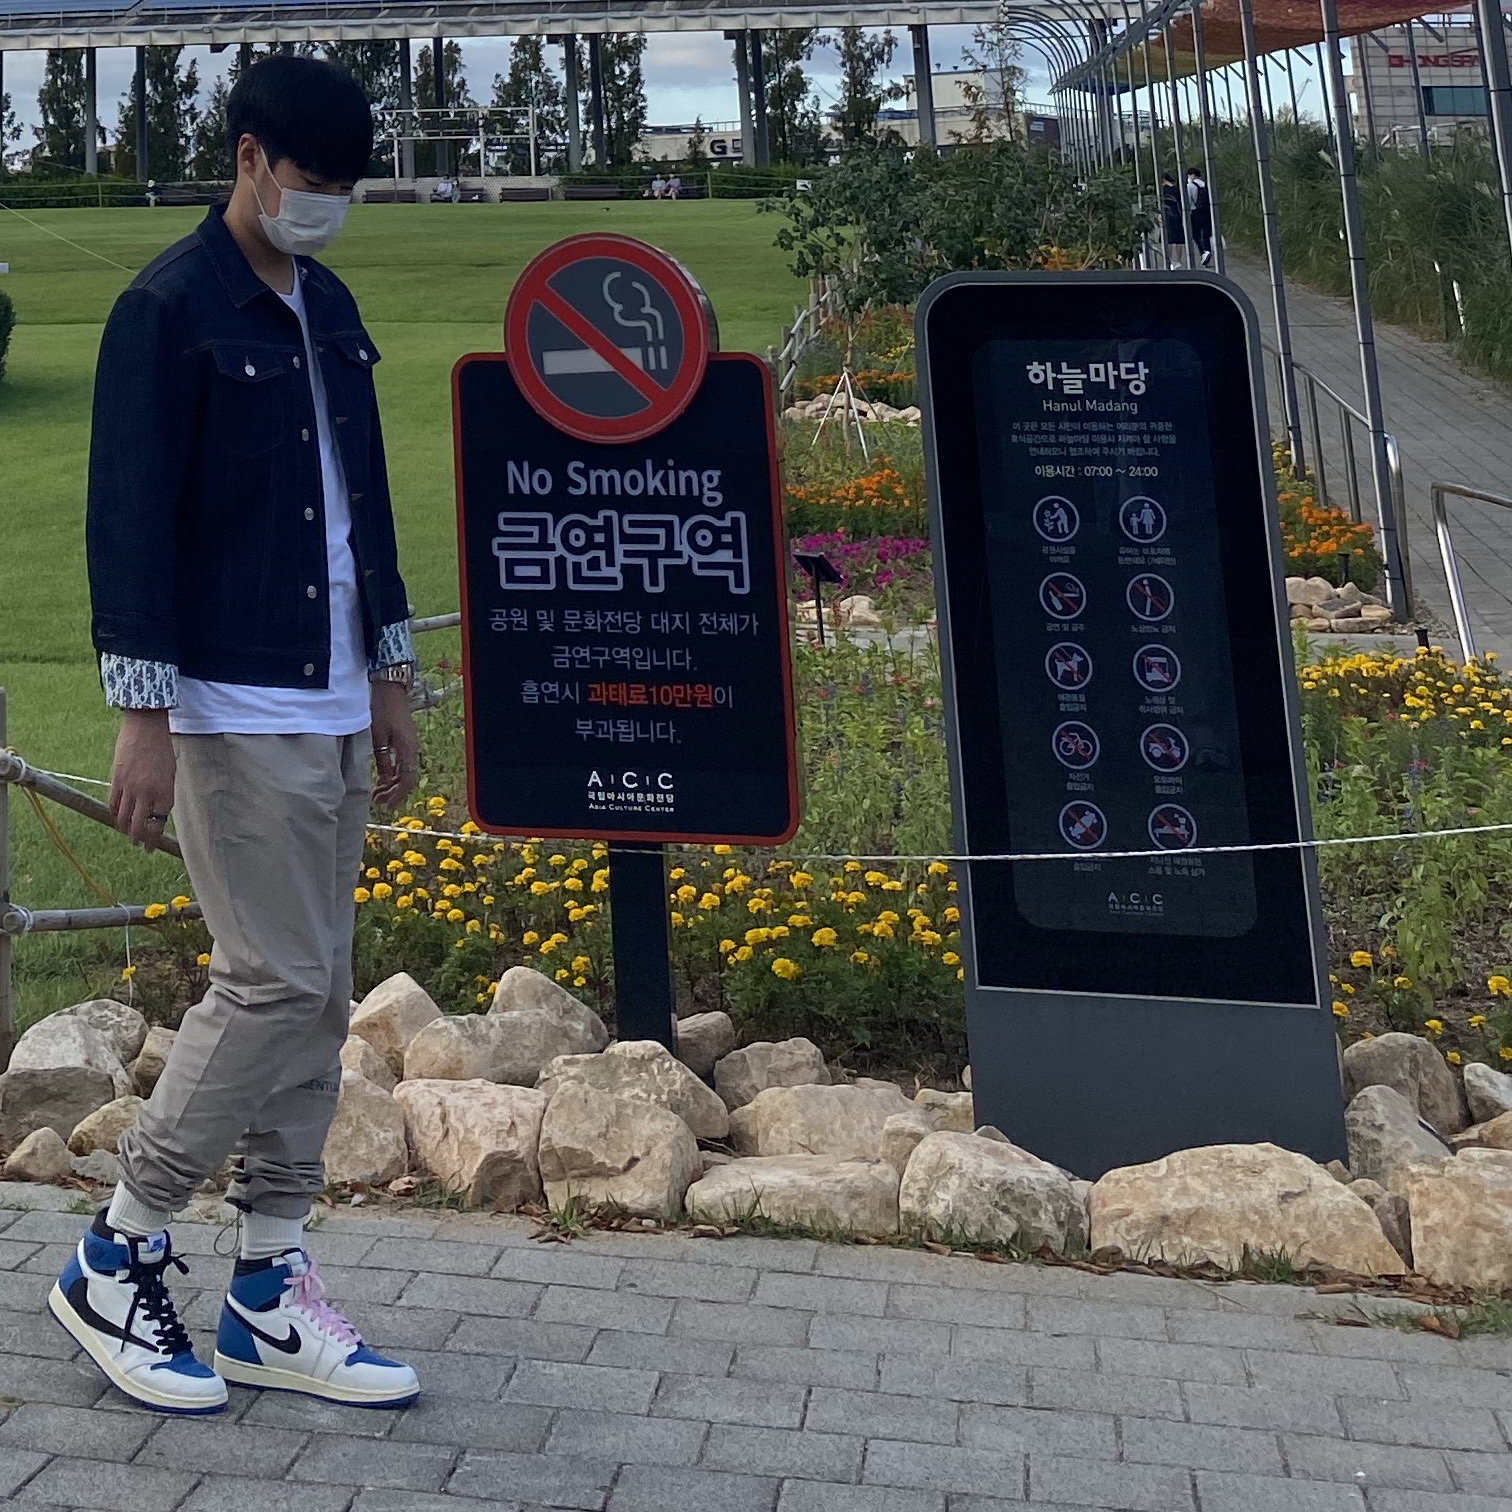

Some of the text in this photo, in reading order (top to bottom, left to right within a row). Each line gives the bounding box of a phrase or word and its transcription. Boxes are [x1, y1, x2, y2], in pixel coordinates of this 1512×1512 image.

[1026, 360, 1149, 396] 하늘마당
[1043, 399, 1138, 414] Hanul Madang
[507, 459, 723, 507] No Smoking
[1034, 465, 1075, 478] 이용시간
[1084, 465, 1113, 477] 07:00
[1128, 465, 1159, 477] 24:00
[492, 509, 751, 594] 금연구역
[488, 609, 759, 637] 공원 및 문화전당 대지 전체가
[551, 645, 698, 672] 금연구역입니다.
[520, 680, 734, 709] 흡연시 과태료10만원이
[574, 718, 682, 745] 부과됩니다.
